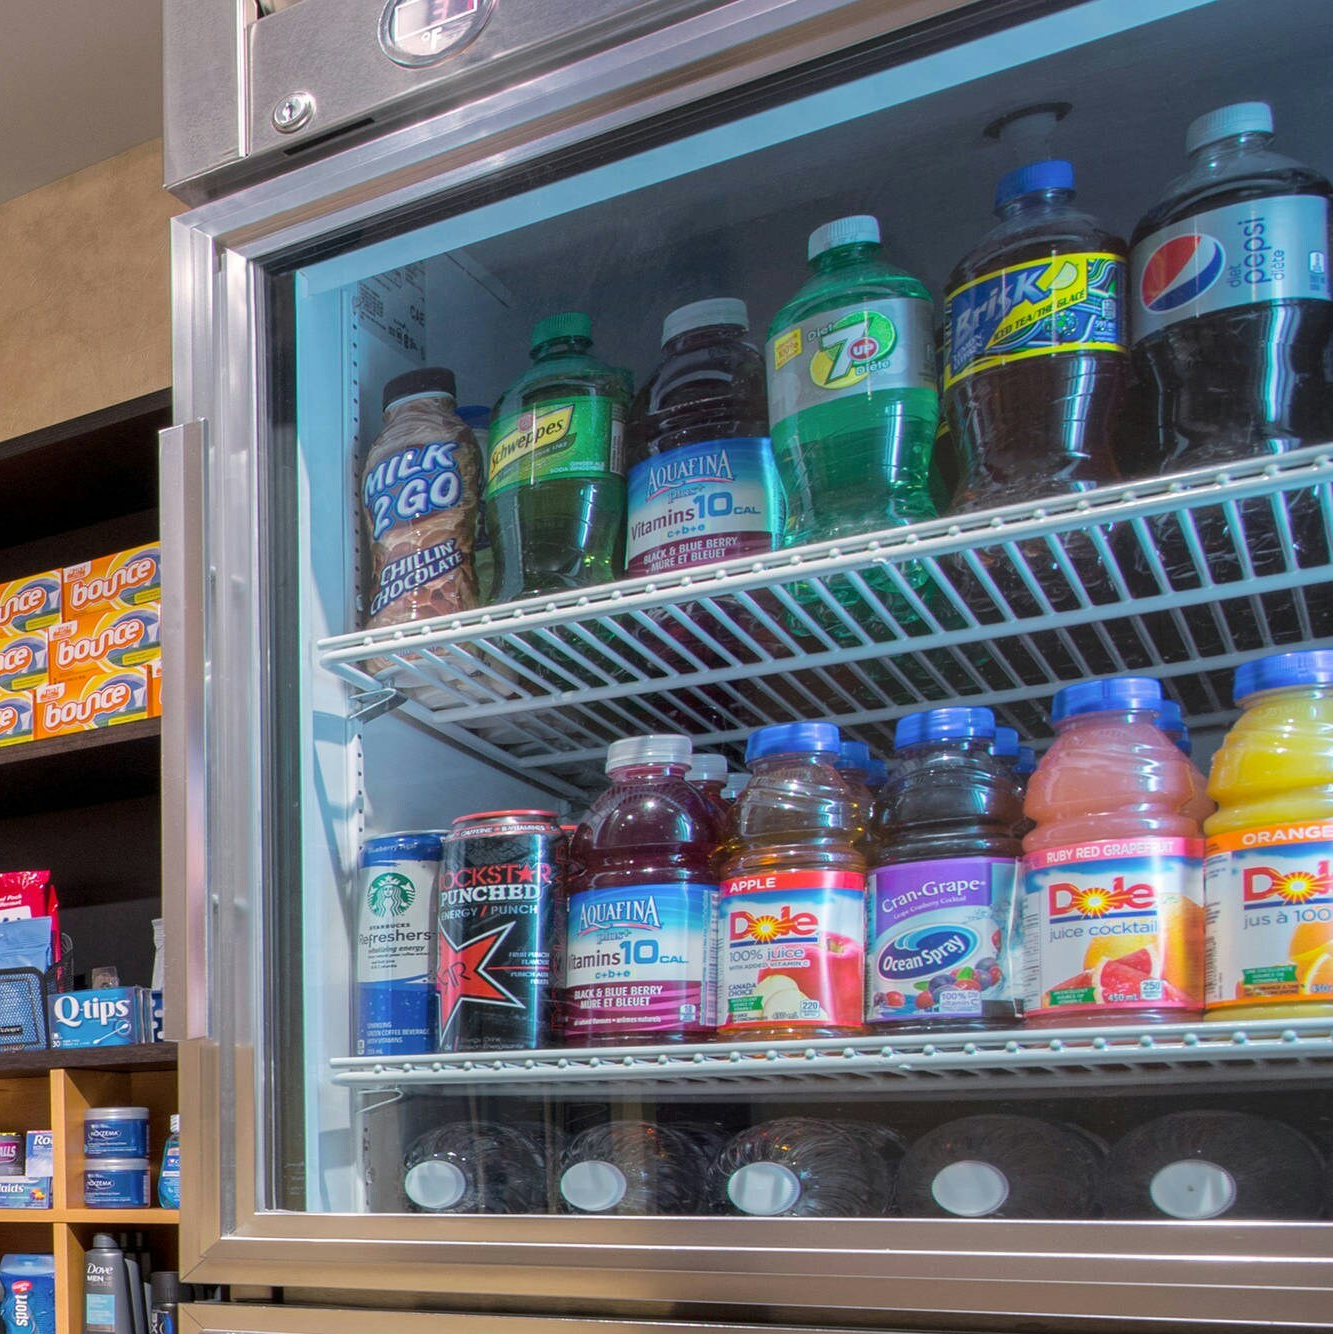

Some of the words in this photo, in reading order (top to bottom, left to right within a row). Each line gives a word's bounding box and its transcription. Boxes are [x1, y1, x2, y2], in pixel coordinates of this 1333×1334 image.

[1239, 215, 1267, 285] pepsi
[1272, 248, 1284, 281] diète
[1228, 264, 1242, 288] diet
[807, 321, 835, 343] Diet
[992, 323, 1015, 343] ICED
[822, 321, 871, 384] 7
[853, 345, 875, 358] UP
[855, 358, 891, 375] Diète
[490, 418, 564, 471] Schweppes
[364, 440, 461, 501] MILK
[646, 448, 734, 492] AQUAFINA
[371, 495, 395, 541] 2
[396, 470, 463, 518] GO
[631, 507, 694, 541] Vitamins
[693, 492, 733, 519] 10
[733, 504, 761, 516] CAL
[381, 538, 458, 582] CHILLIN'
[370, 550, 463, 616] CHOCOLATE
[1046, 849, 1074, 864] RUBY
[1076, 847, 1100, 859] RED
[1102, 840, 1174, 857] GRAPEFRUIT
[441, 884, 541, 907] PUNCHED
[729, 877, 776, 893] APPLE
[882, 877, 980, 914] Cran-Grape
[441, 908, 478, 920] ENERGY
[491, 904, 538, 915] PUNCH
[729, 906, 819, 941] Dole
[358, 928, 432, 947] Refreshers
[883, 951, 922, 972] Ocean
[922, 933, 966, 970] Spray
[729, 949, 763, 962] 100%
[765, 947, 804, 960] juice
[574, 988, 594, 999] BLACK
[596, 988, 602, 997] &
[604, 987, 627, 997] BLUE
[630, 985, 663, 996] BERRY
[87, 1263, 113, 1274] Dove
[15, 1294, 27, 1326] sport
